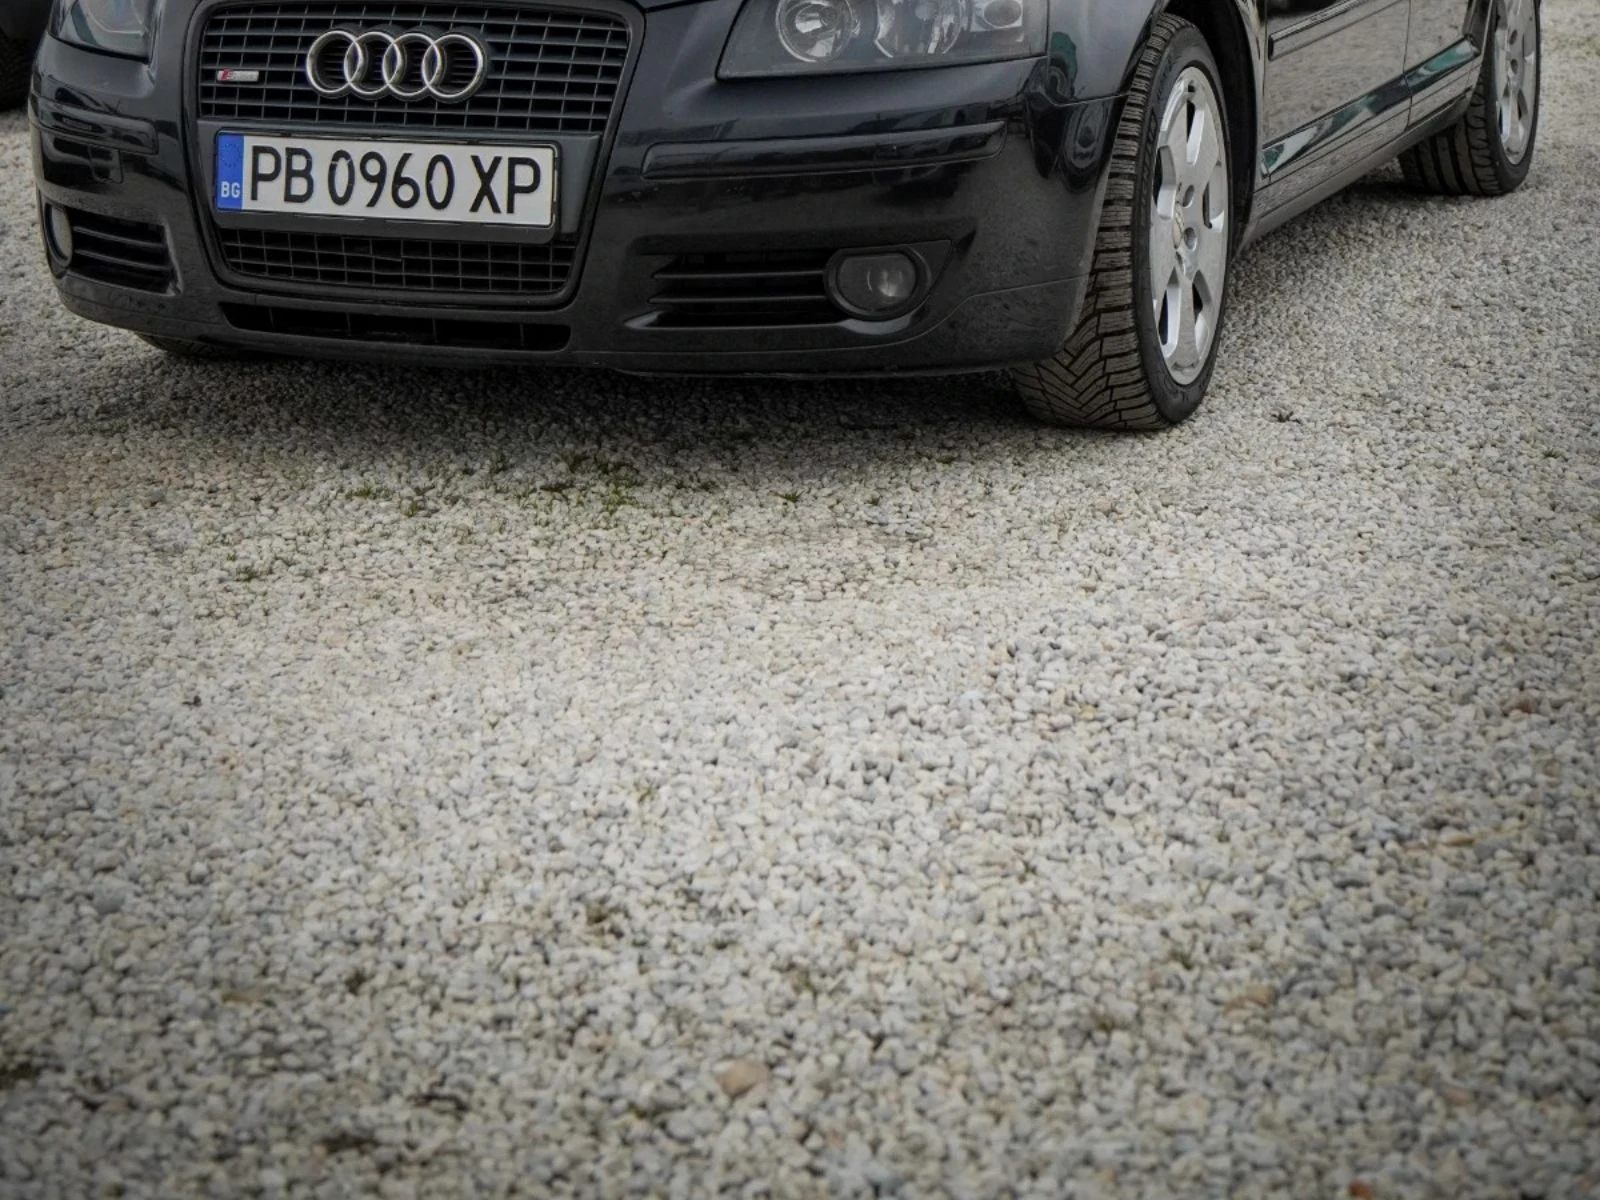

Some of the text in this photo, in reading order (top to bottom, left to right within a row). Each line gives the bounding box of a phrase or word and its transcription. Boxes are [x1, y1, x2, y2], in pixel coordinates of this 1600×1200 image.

[220, 181, 241, 199] BG
[251, 145, 541, 214] PB 0960 XP
